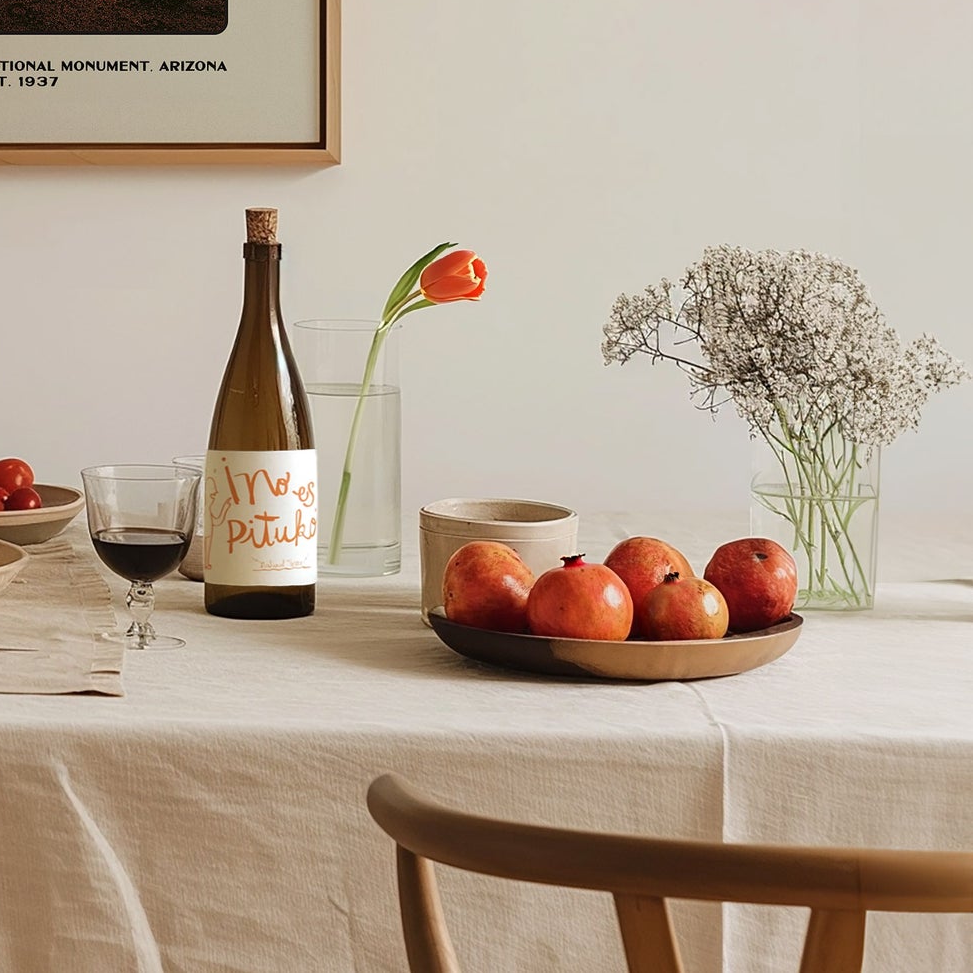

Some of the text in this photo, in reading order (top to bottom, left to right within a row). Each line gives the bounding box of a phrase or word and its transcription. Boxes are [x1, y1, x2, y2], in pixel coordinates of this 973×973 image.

[158, 60, 228, 72] ARIZONA
[18, 75, 59, 87] 1937
[292, 481, 315, 507] es
